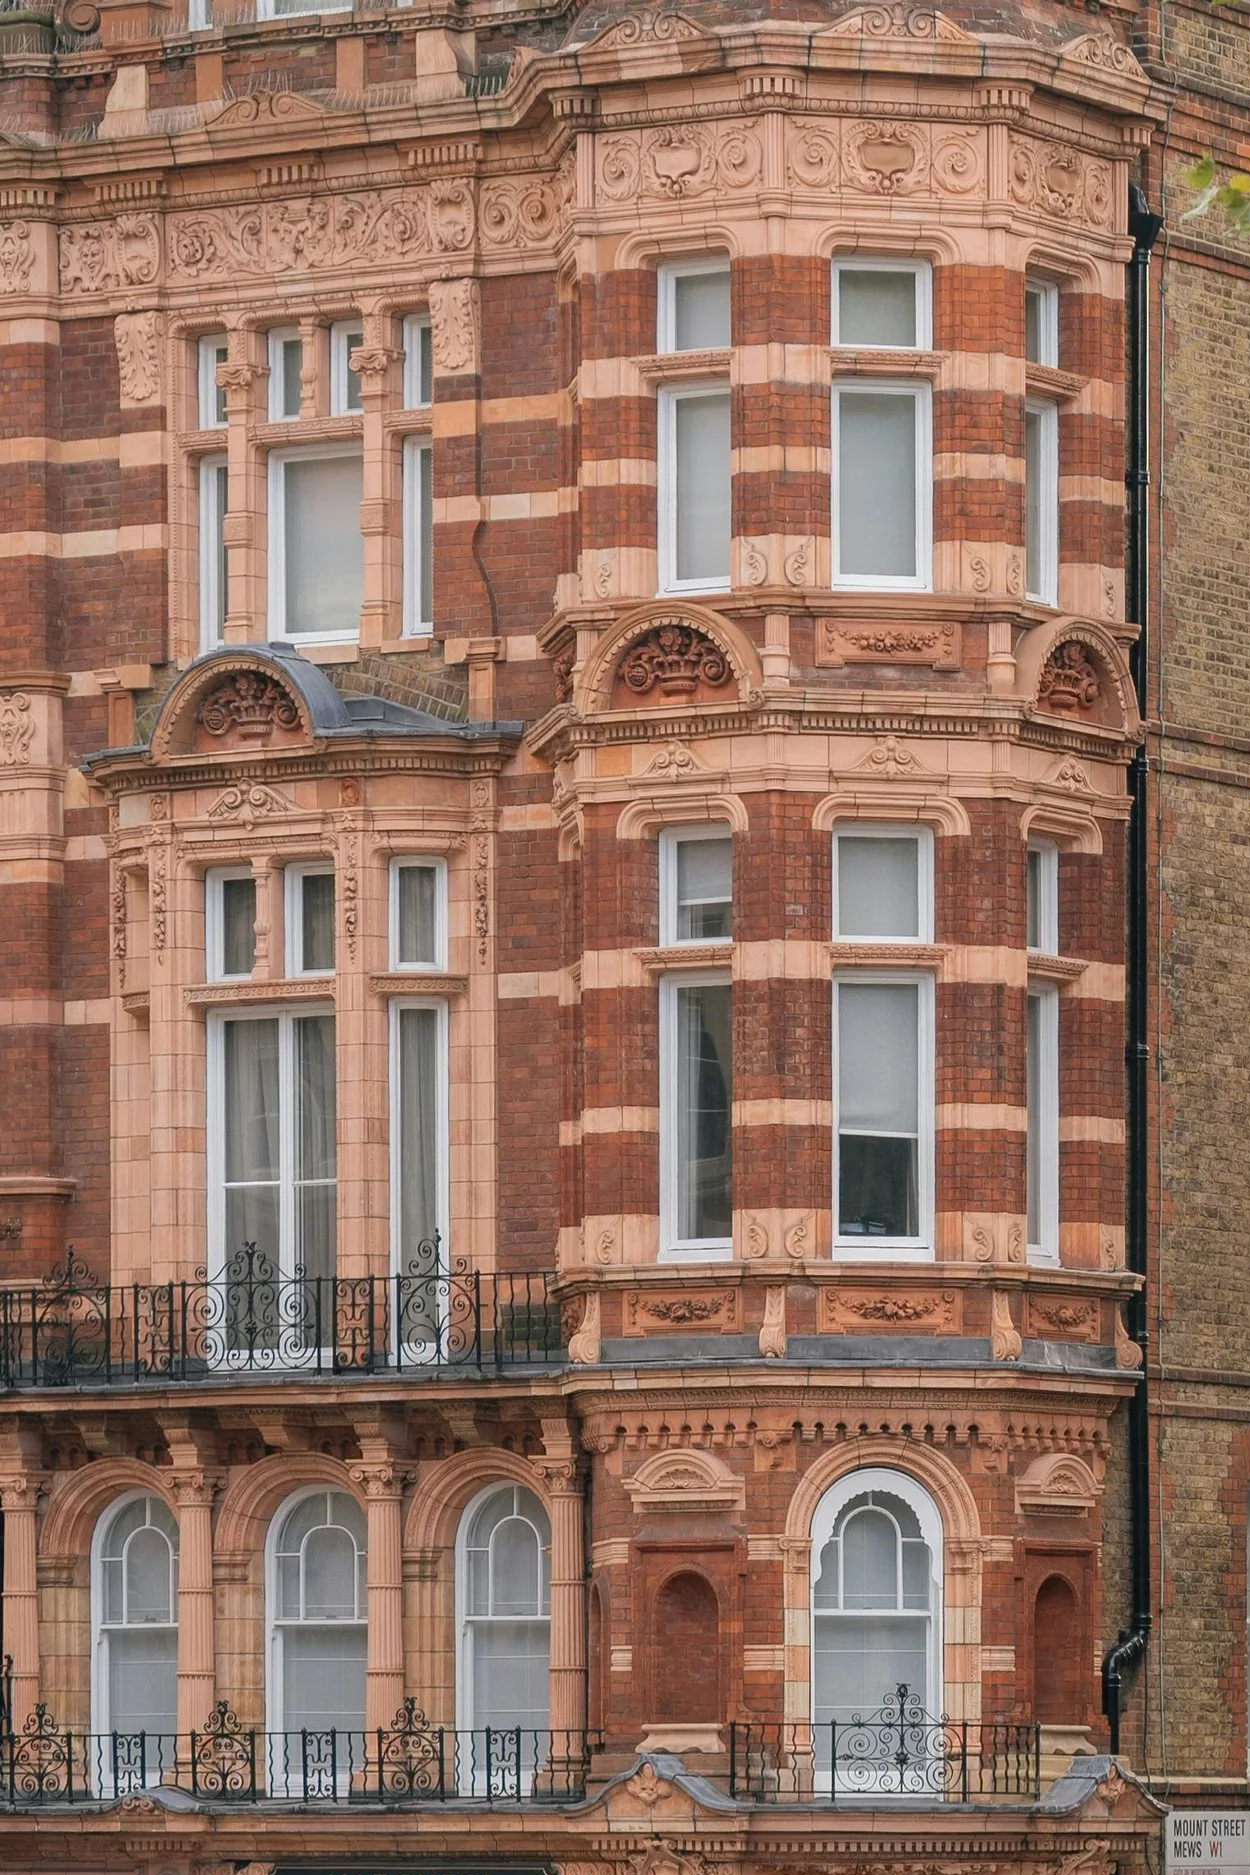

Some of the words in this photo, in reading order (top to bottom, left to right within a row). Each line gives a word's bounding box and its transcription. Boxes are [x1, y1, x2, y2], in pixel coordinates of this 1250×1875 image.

[1173, 1819, 1208, 1837] MOUNT
[1211, 1819, 1246, 1837] STREET
[1173, 1841, 1202, 1858] MEWS
[1209, 1841, 1223, 1858] W1
